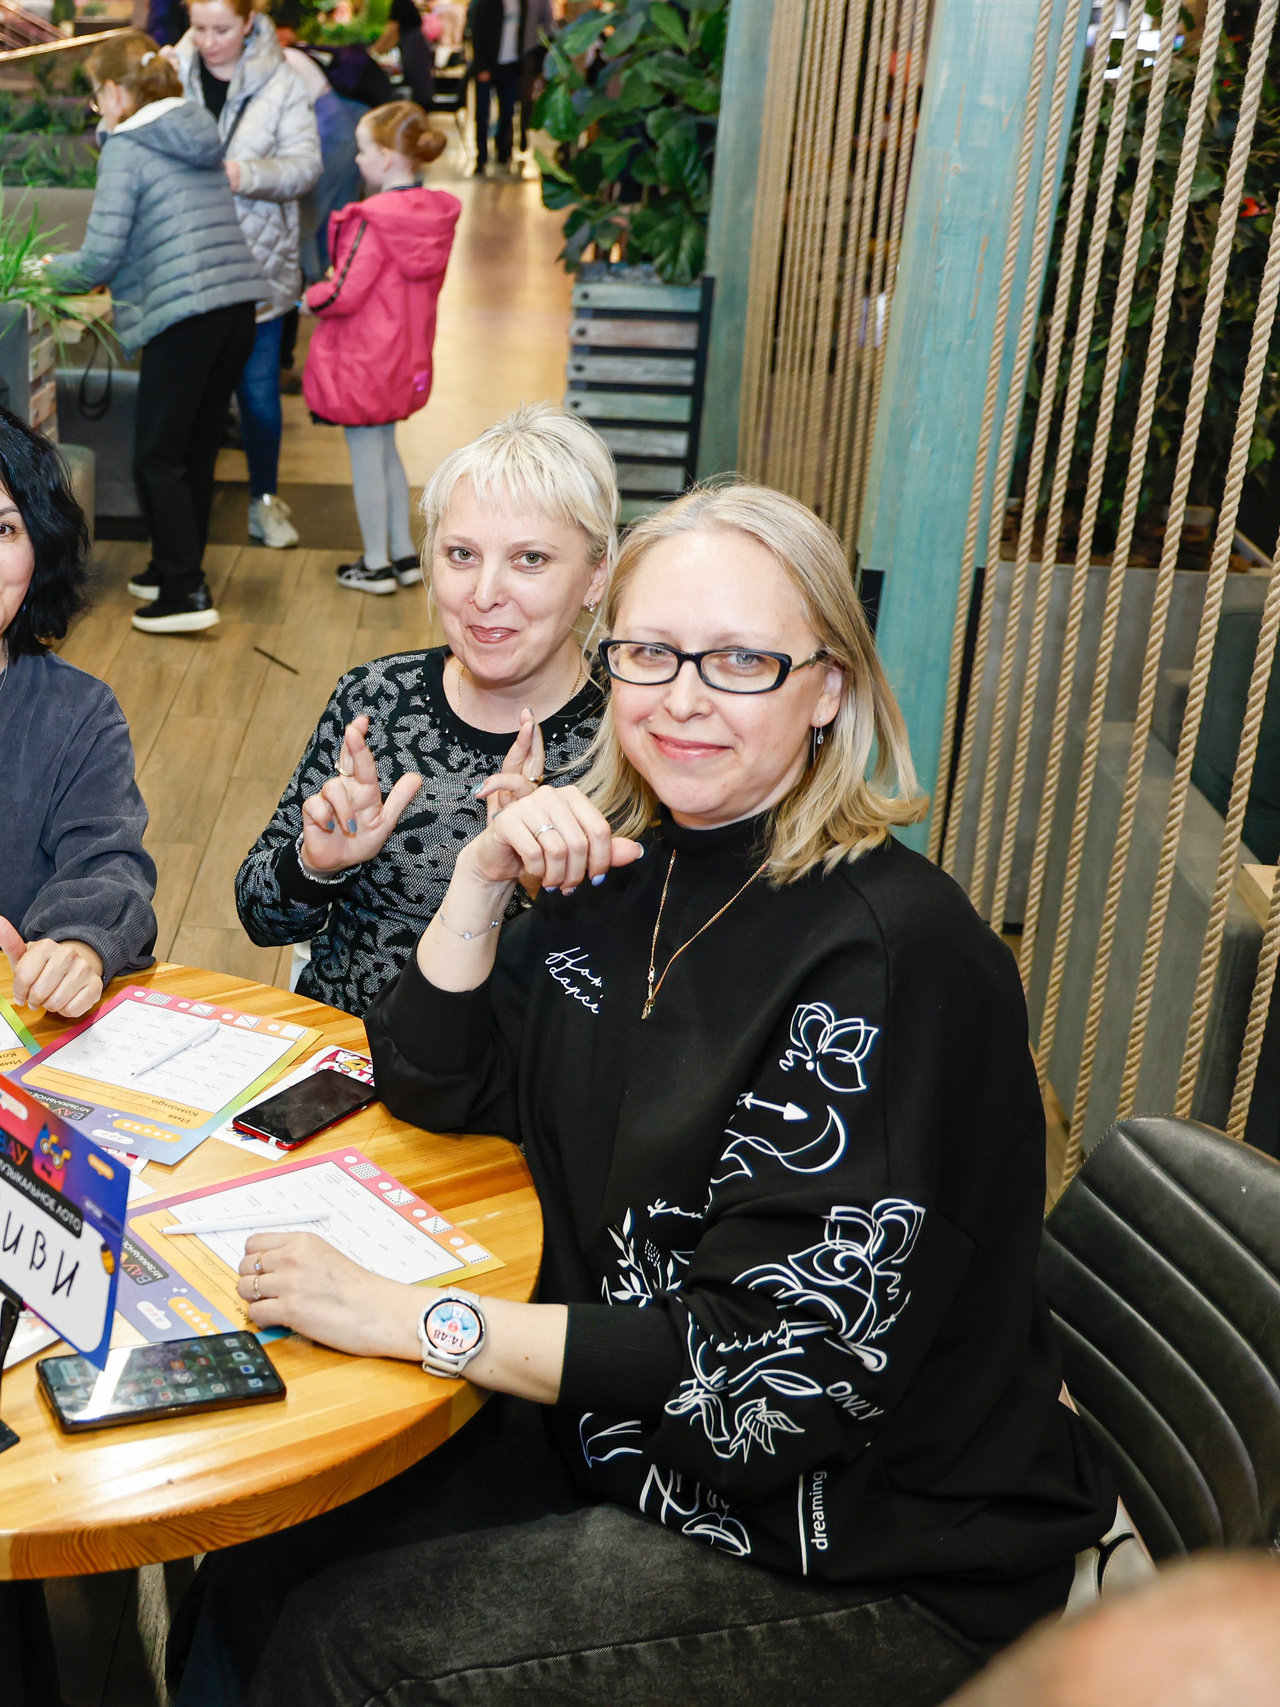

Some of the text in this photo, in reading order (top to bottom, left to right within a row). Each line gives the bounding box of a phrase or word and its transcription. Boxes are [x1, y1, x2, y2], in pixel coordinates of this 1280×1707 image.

[151, 1098, 199, 1118] Команда
[55, 1203, 83, 1232] ЛОТО
[433, 1328, 465, 1349] 14:48
[825, 1380, 885, 1421] ONLY
[808, 1470, 829, 1551] dreaming
